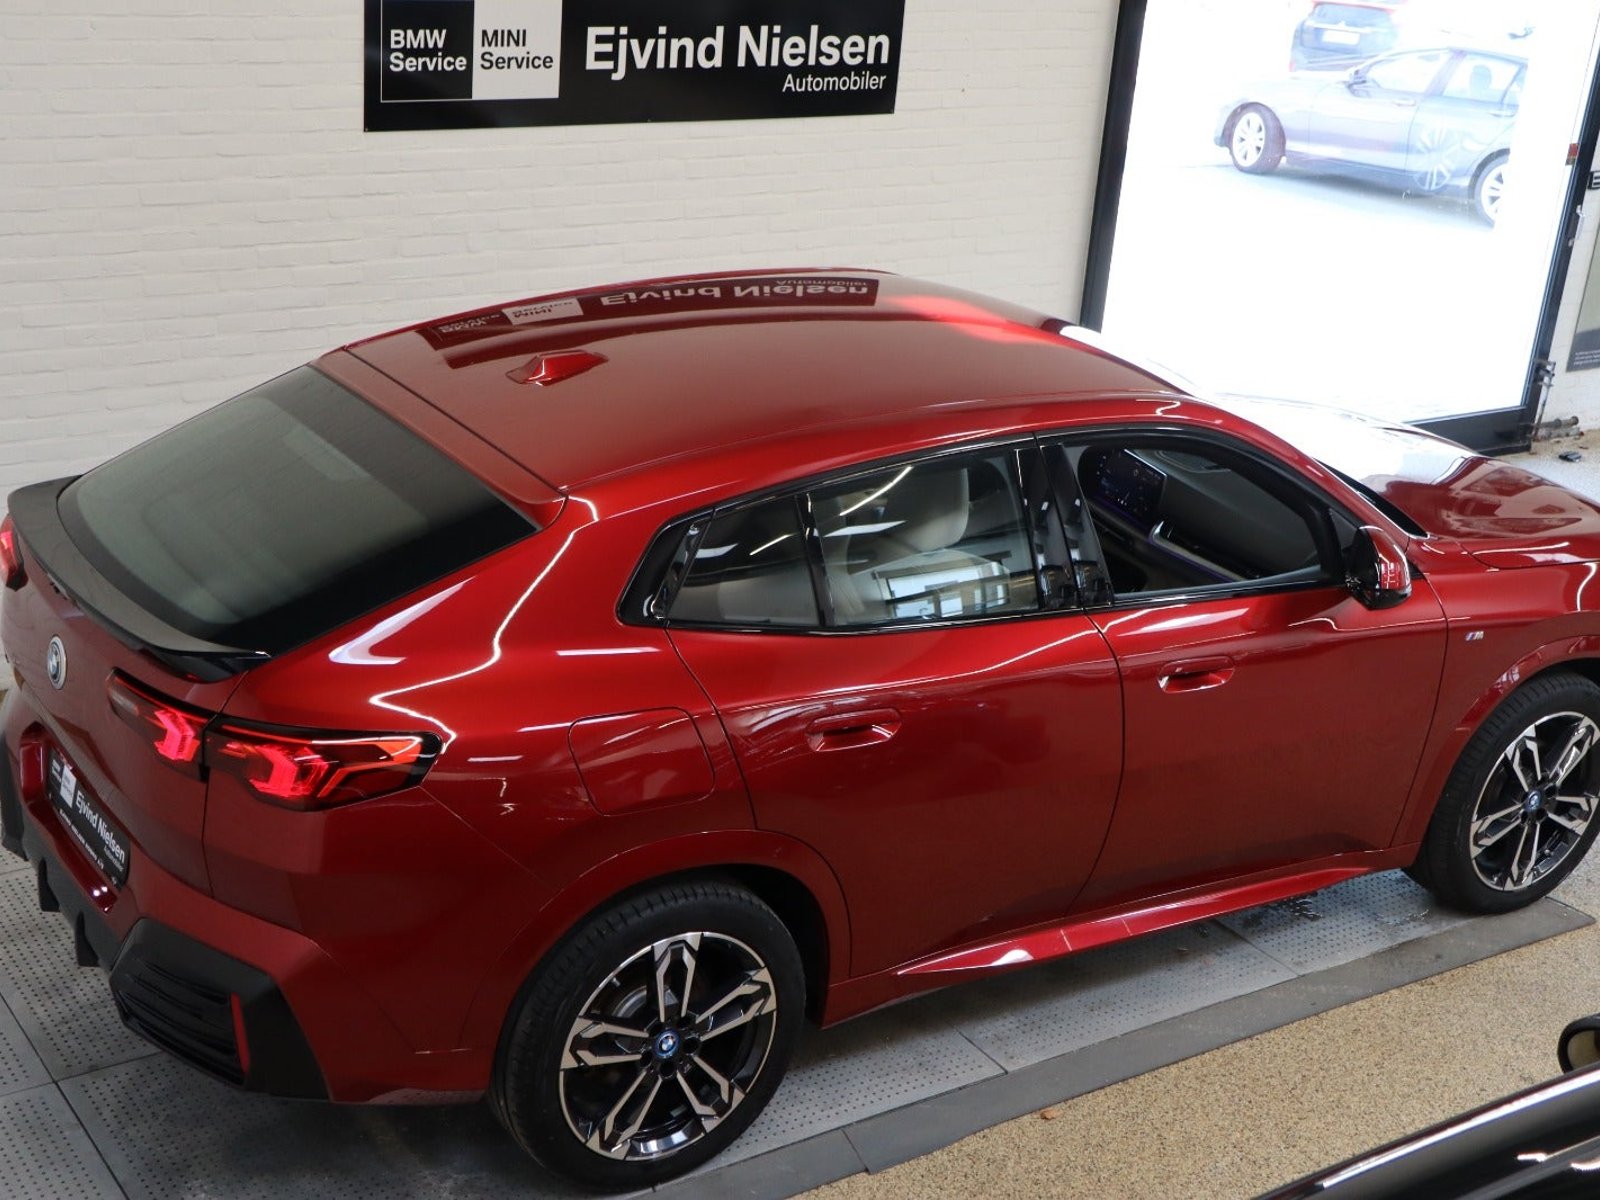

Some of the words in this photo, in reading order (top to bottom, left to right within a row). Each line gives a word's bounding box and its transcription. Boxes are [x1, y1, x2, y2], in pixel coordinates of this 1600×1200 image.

[390, 29, 447, 49] BMW
[481, 29, 527, 48] MINI
[389, 52, 467, 72] Service
[480, 51, 554, 70] Service
[585, 26, 725, 81] Ejvind
[737, 25, 890, 67] Nielsen
[782, 71, 887, 93] Automobiler
[75, 790, 99, 829] Ejvind
[98, 817, 125, 864] Nielsen
